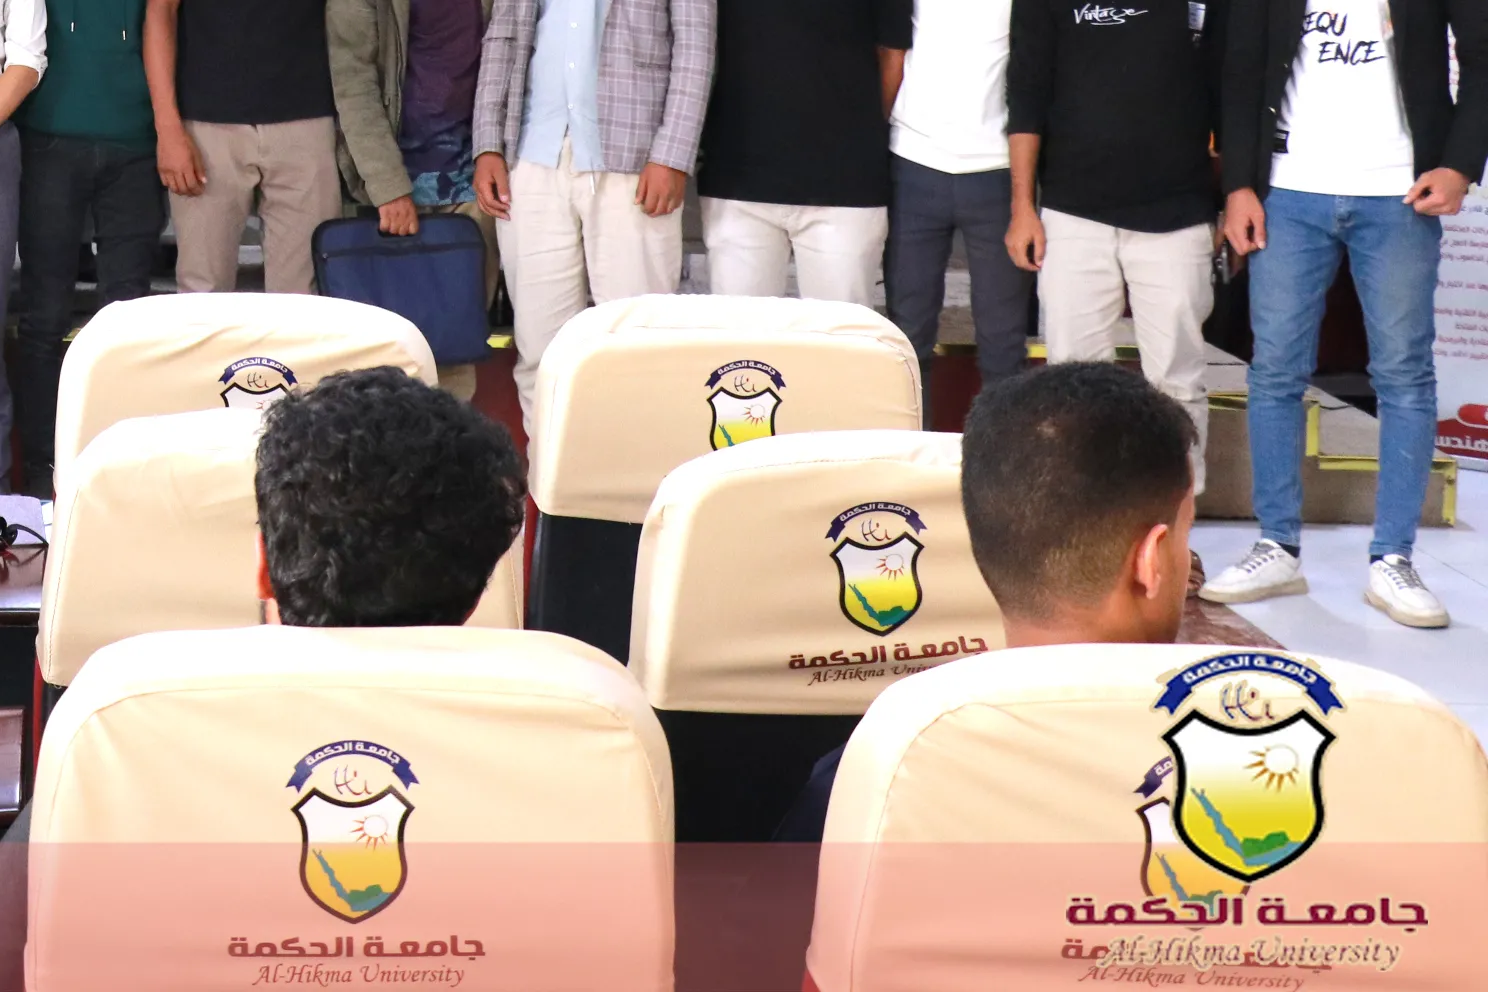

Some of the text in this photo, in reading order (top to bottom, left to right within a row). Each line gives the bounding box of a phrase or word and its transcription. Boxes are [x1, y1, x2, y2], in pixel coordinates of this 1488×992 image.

[1300, 11, 1348, 37] EQU
[1318, 29, 1387, 66] ENCE
[789, 645, 887, 670] الحكمة
[894, 636, 988, 655] جامعة
[808, 666, 885, 686] Al-Hikma
[305, 742, 401, 766] جامعة الحكمة
[227, 934, 486, 961] جامعة الحكمة
[252, 963, 465, 988] Al-Hikma University
[1078, 964, 1306, 992] Al-Hikma University
